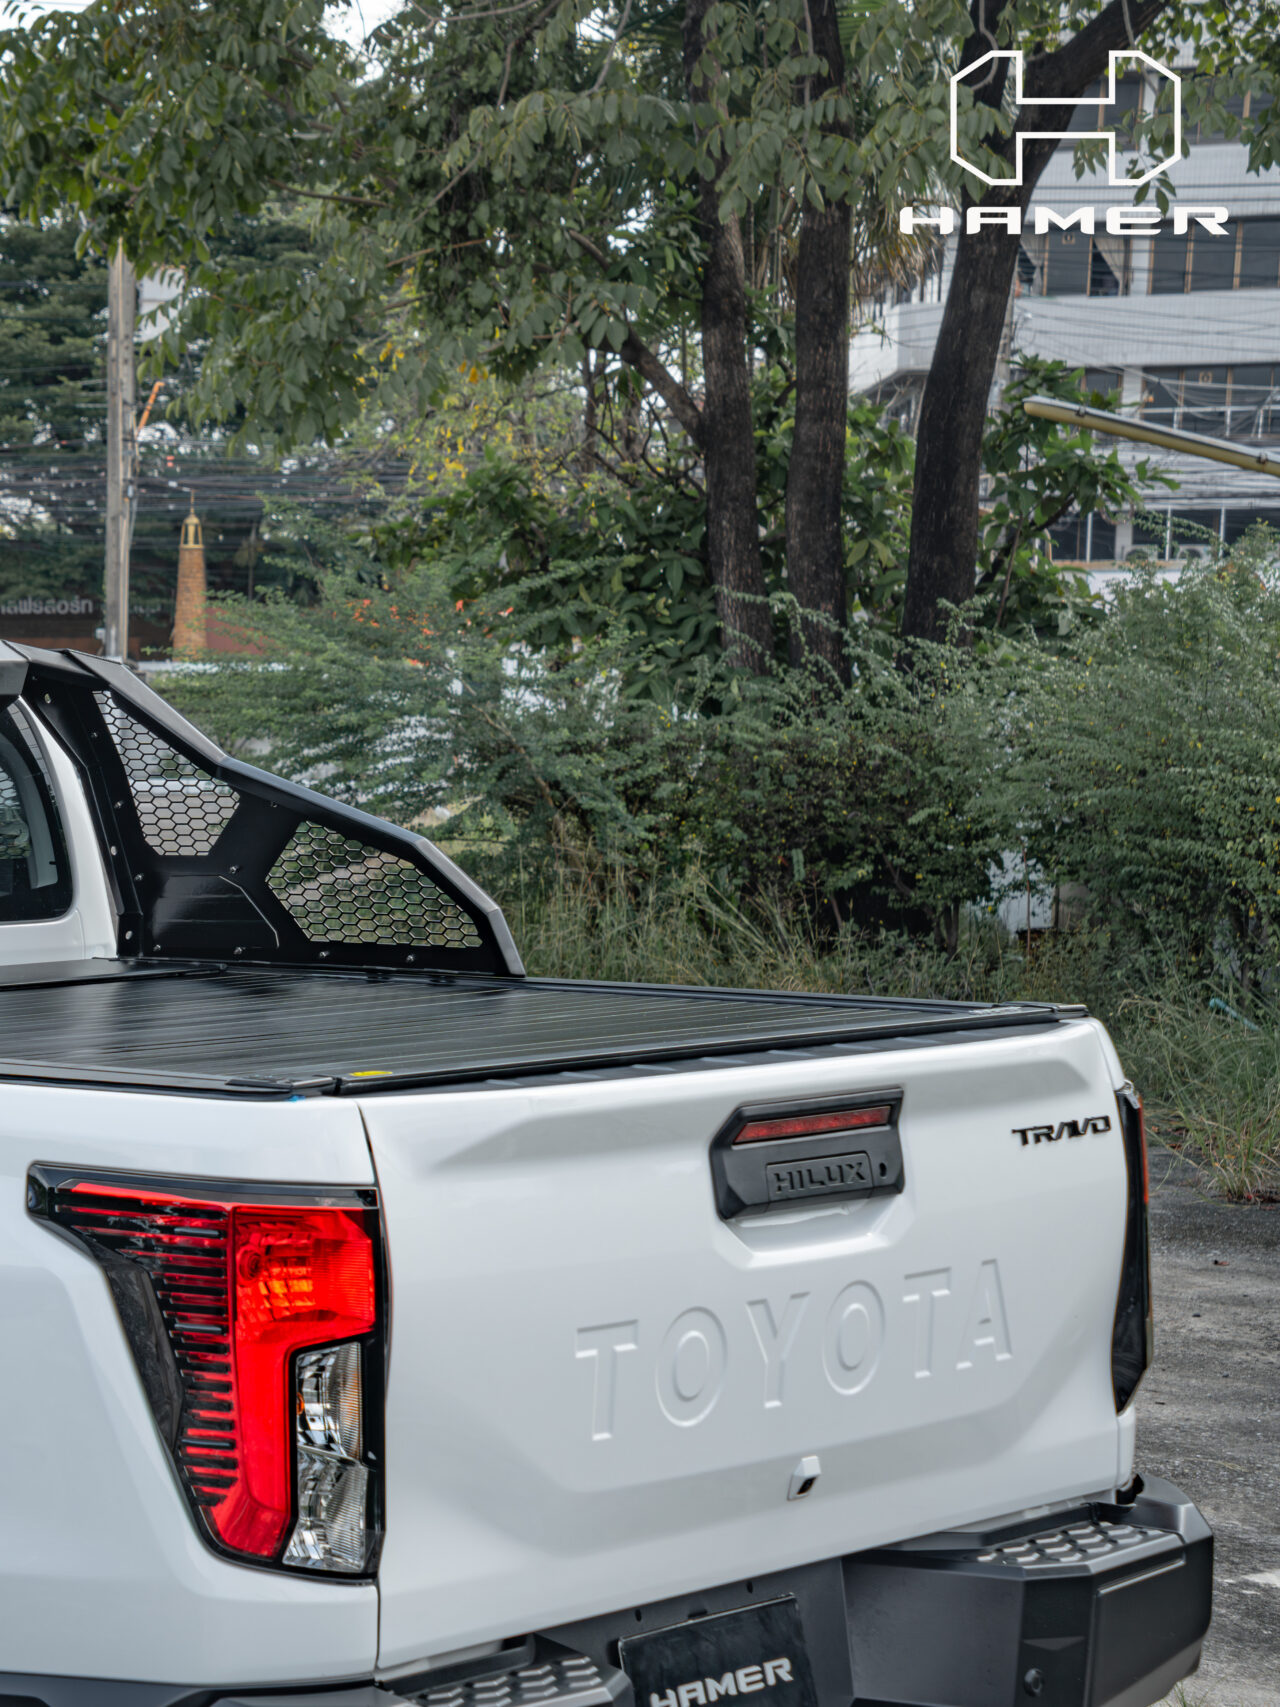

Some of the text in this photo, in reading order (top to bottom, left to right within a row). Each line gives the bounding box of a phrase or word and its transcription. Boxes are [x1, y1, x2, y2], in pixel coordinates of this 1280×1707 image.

[1011, 1115, 1111, 1146] TRAVO
[774, 1161, 866, 1194] HILUX
[575, 1258, 1013, 1441] TOYOTA
[650, 1657, 794, 1707] HAMER
